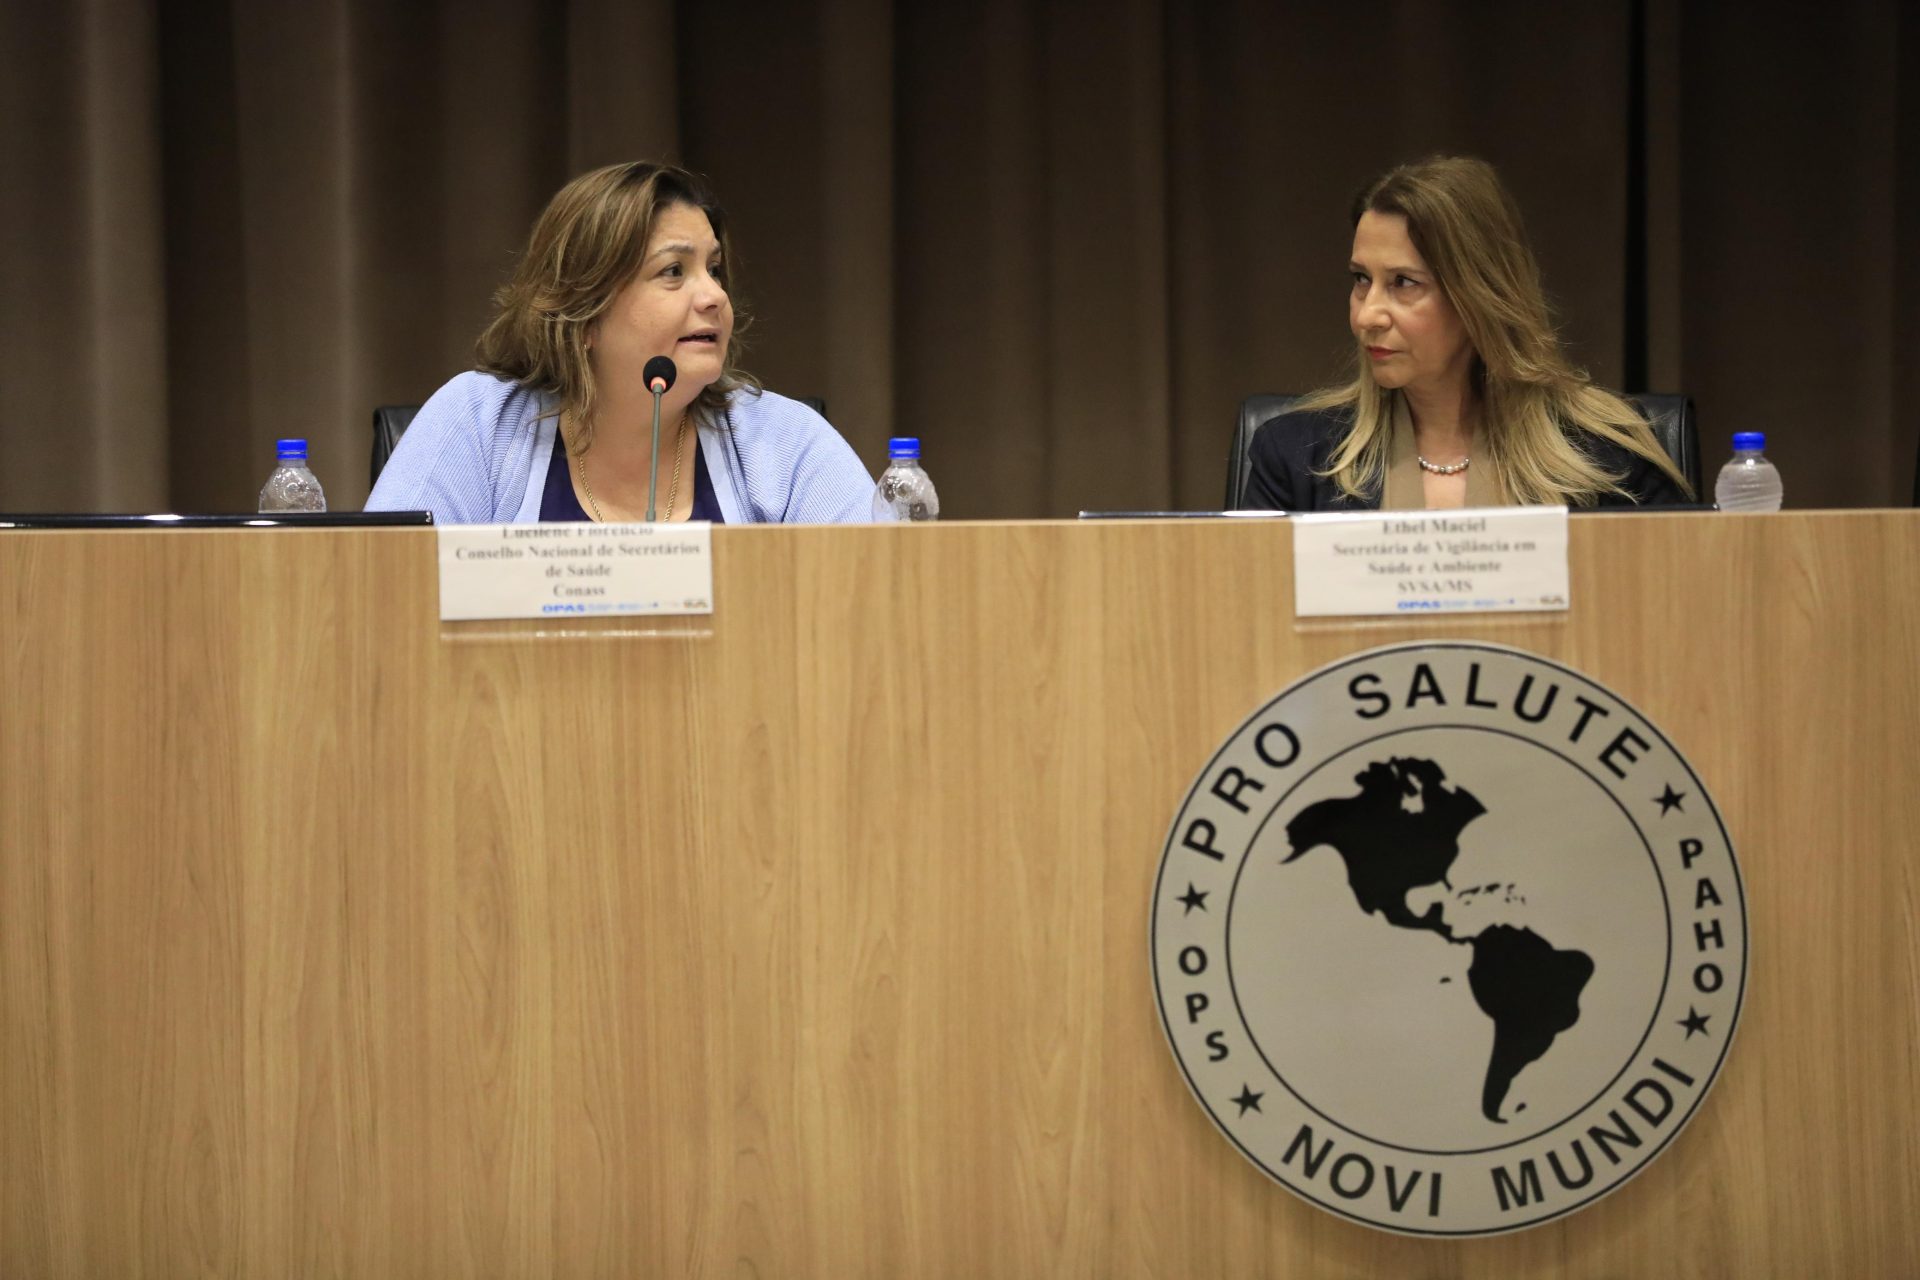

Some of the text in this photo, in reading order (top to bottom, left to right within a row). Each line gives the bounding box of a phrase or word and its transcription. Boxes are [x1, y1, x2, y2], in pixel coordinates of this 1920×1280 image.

[1431, 517, 1486, 534] Maciel
[455, 541, 701, 560] Conselho Nacional de Secretários
[1412, 541, 1429, 554] de
[1514, 541, 1536, 551] em
[545, 565, 562, 578] de
[1430, 559, 1502, 574] Ambiente
[553, 584, 606, 598] Conass
[542, 603, 585, 613] OPAS
[1181, 662, 1652, 862] PRO SALUTE
[1679, 837, 1725, 995] PAHO
[1178, 945, 1229, 1063] OPS
[1281, 1057, 1696, 1218] NOVI MUNDI
